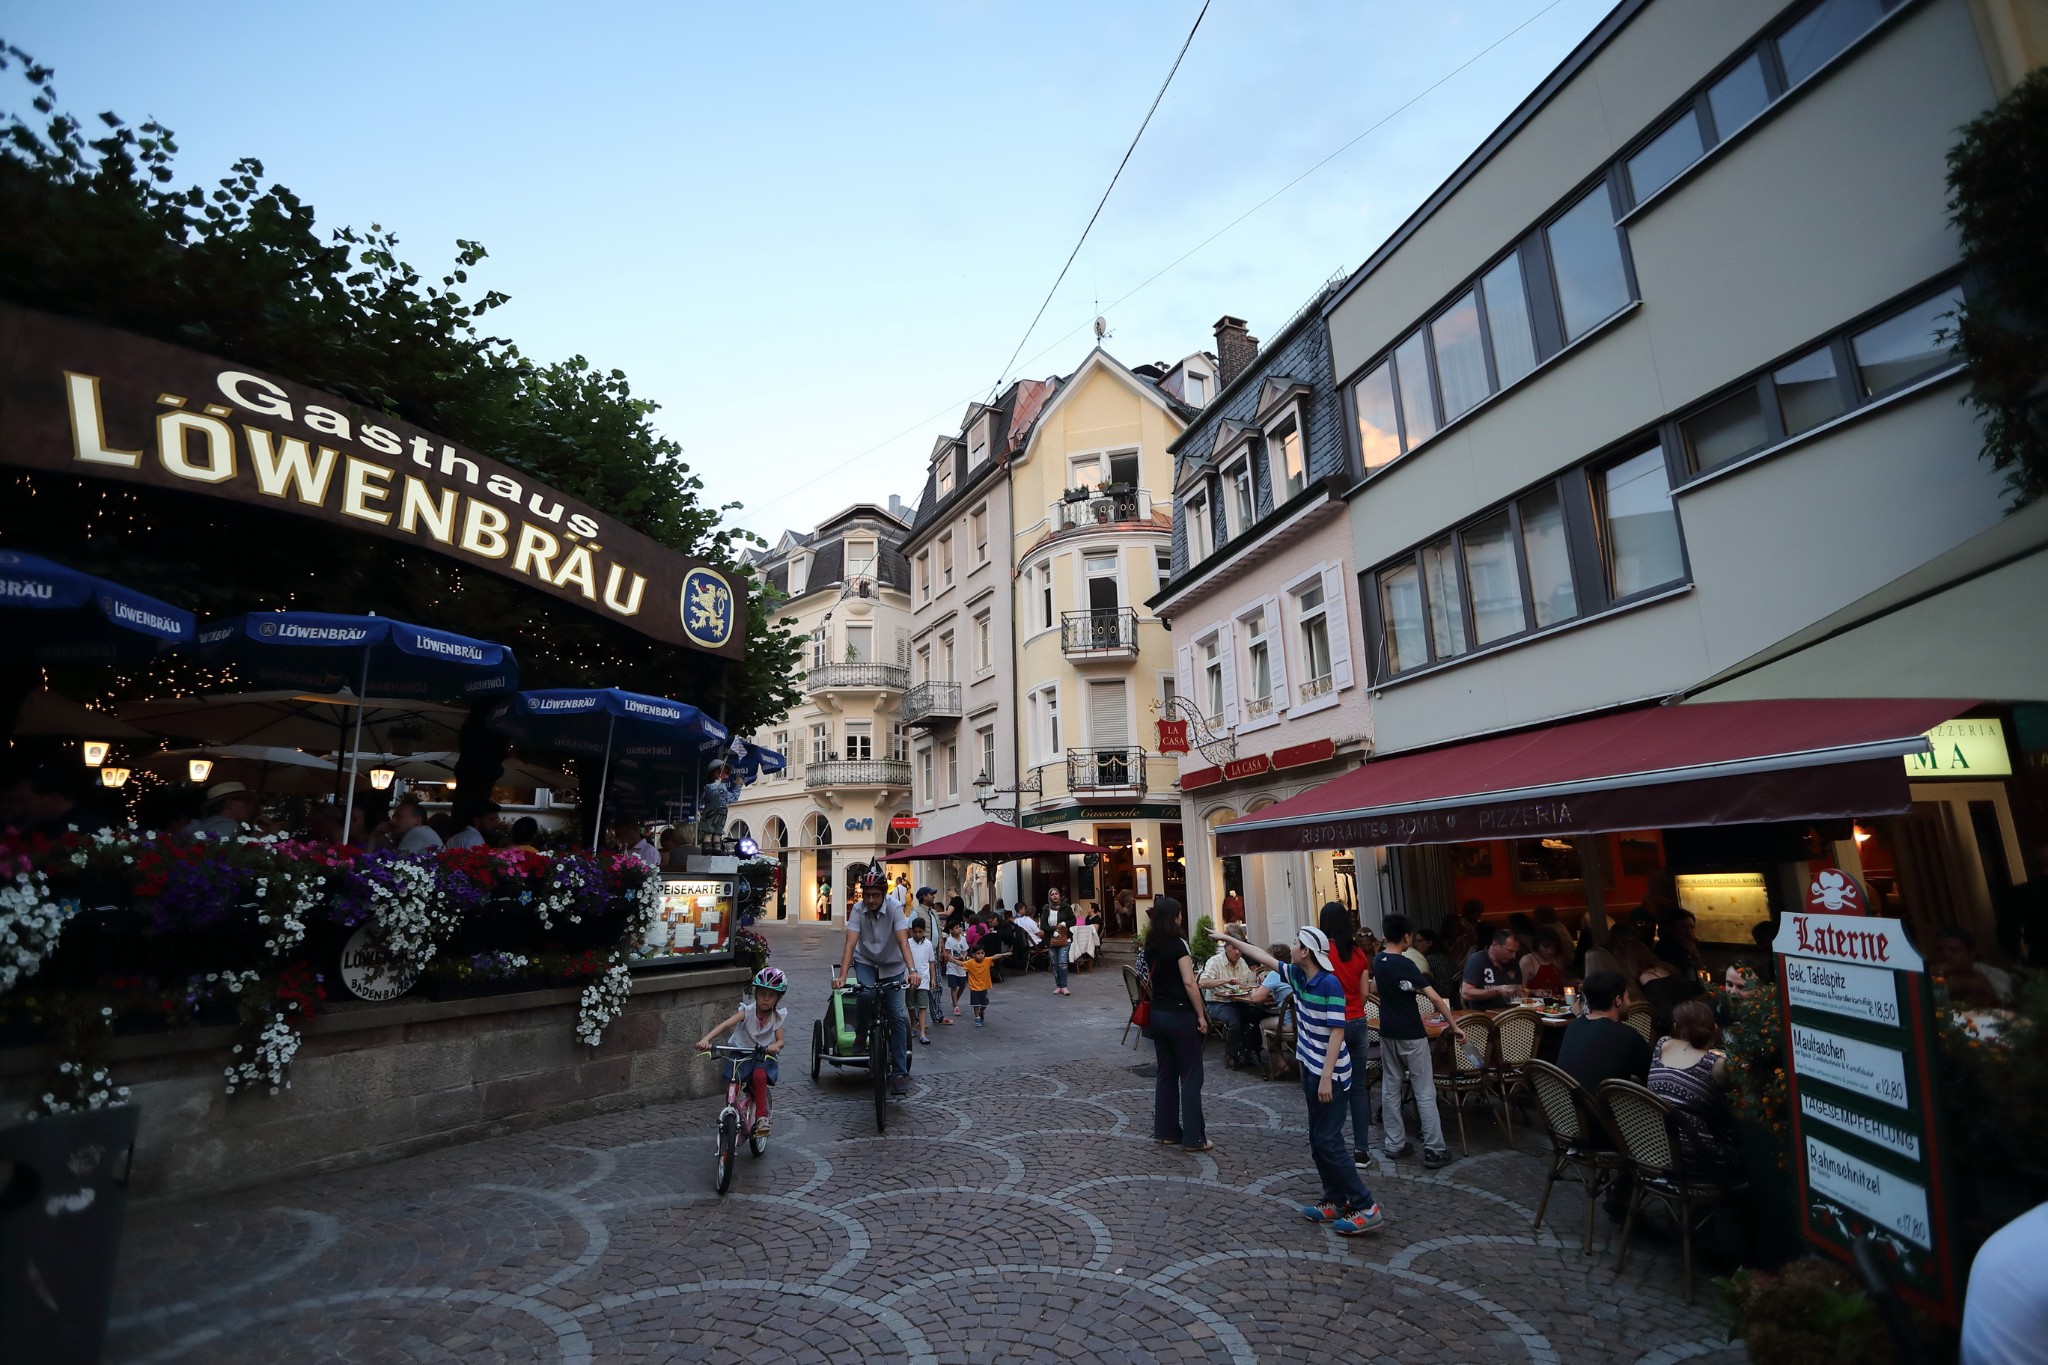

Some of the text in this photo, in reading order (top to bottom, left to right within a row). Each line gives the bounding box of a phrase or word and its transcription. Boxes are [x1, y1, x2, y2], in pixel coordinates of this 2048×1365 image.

[217, 371, 600, 538] Gasthaus
[63, 370, 648, 617] LÖWENBRÄU
[114, 600, 181, 634] LÖWENBRÄU
[278, 623, 367, 640] LÖWENBRÄU
[416, 635, 483, 660] LÖWENBRÄU
[540, 697, 596, 709] LÖWENBRÄU
[624, 699, 681, 720] LÖWENBRÄU
[1162, 736, 1185, 746] CASA
[1167, 726, 1179, 735] LA
[1930, 724, 1996, 737] IZZERIA
[1231, 759, 1263, 776] LA CASA
[1080, 807, 1141, 818] Casserole
[1302, 802, 1573, 844] RISTORANTE ROMA PIZZERIA
[658, 884, 721, 895] PEISEKARTE
[1793, 916, 1890, 962] Laterne
[1484, 968, 1496, 984] 3
[1788, 962, 1846, 995] Gek. Tafelspitz
[351, 979, 411, 1000] BADEN BADE
[1793, 1029, 1846, 1061] Maultaschen
[1875, 1078, 1904, 1101] €12,80
[1803, 1095, 1914, 1151] TAGESEMPFEHLUNG
[1810, 1144, 1881, 1195] Rahmschnitzel
